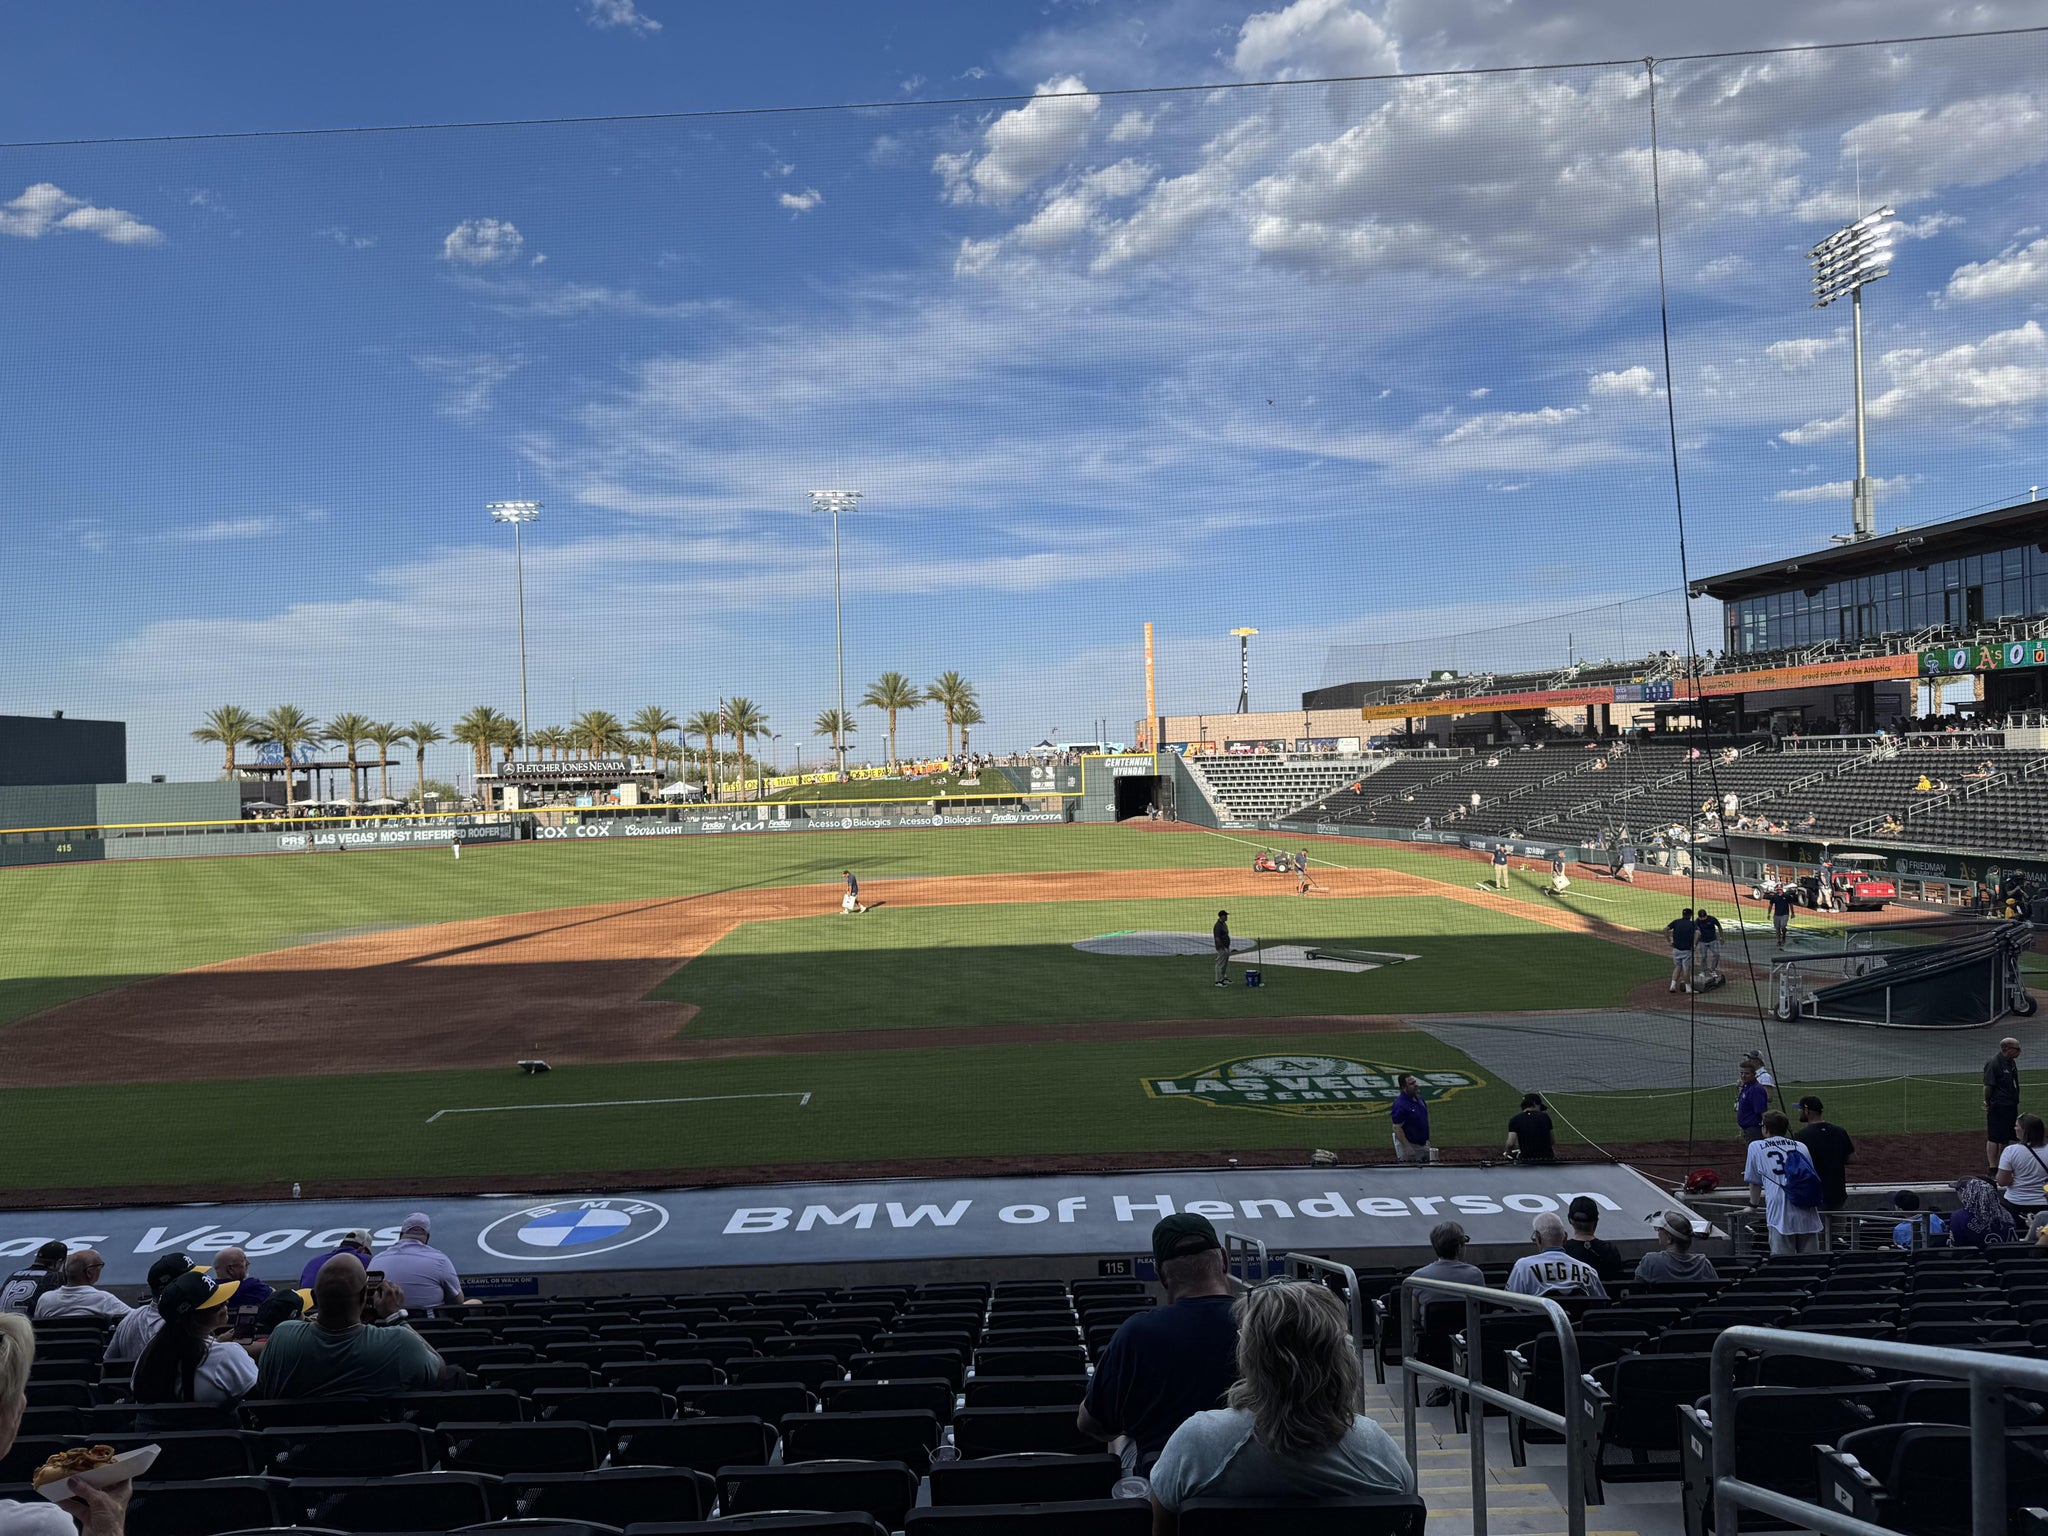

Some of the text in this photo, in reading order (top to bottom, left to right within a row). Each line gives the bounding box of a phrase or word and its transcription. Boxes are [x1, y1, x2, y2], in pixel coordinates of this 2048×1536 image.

[1953, 650, 1966, 670] 0
[2009, 644, 2024, 665] 0
[1801, 671, 1819, 682] proud
[1820, 669, 1842, 680] partner
[1851, 667, 1863, 676] the
[1864, 665, 1891, 674] Athletics
[516, 761, 626, 773] FLETCHER JONES NEVADA
[1105, 757, 1153, 767] CENTENNIAL
[1112, 767, 1146, 776] HYUNDAI
[807, 817, 891, 828] Acesso Biologics
[899, 815, 982, 826] Acesso Biologics
[990, 813, 1062, 823] Findlay TOYOTA
[314, 834, 336, 844] LAS
[338, 832, 377, 843] VEGAS'
[381, 831, 412, 842] MOST
[468, 826, 500, 838] ROOFER
[536, 826, 567, 839] COX
[576, 825, 610, 837] COX
[624, 824, 683, 837] Coors LIGHT
[56, 844, 72, 853] 415
[1909, 860, 1947, 872] FRIEDMAN
[1157, 1077, 1271, 1095] LAS
[1247, 1089, 1402, 1101] SERIES
[525, 1201, 653, 1218] BMW
[722, 1191, 1623, 1234] BMW of Henderson
[133, 1225, 403, 1257] Vegas
[1105, 1262, 1125, 1274] 115
[1530, 1262, 1591, 1285] VEGAS
